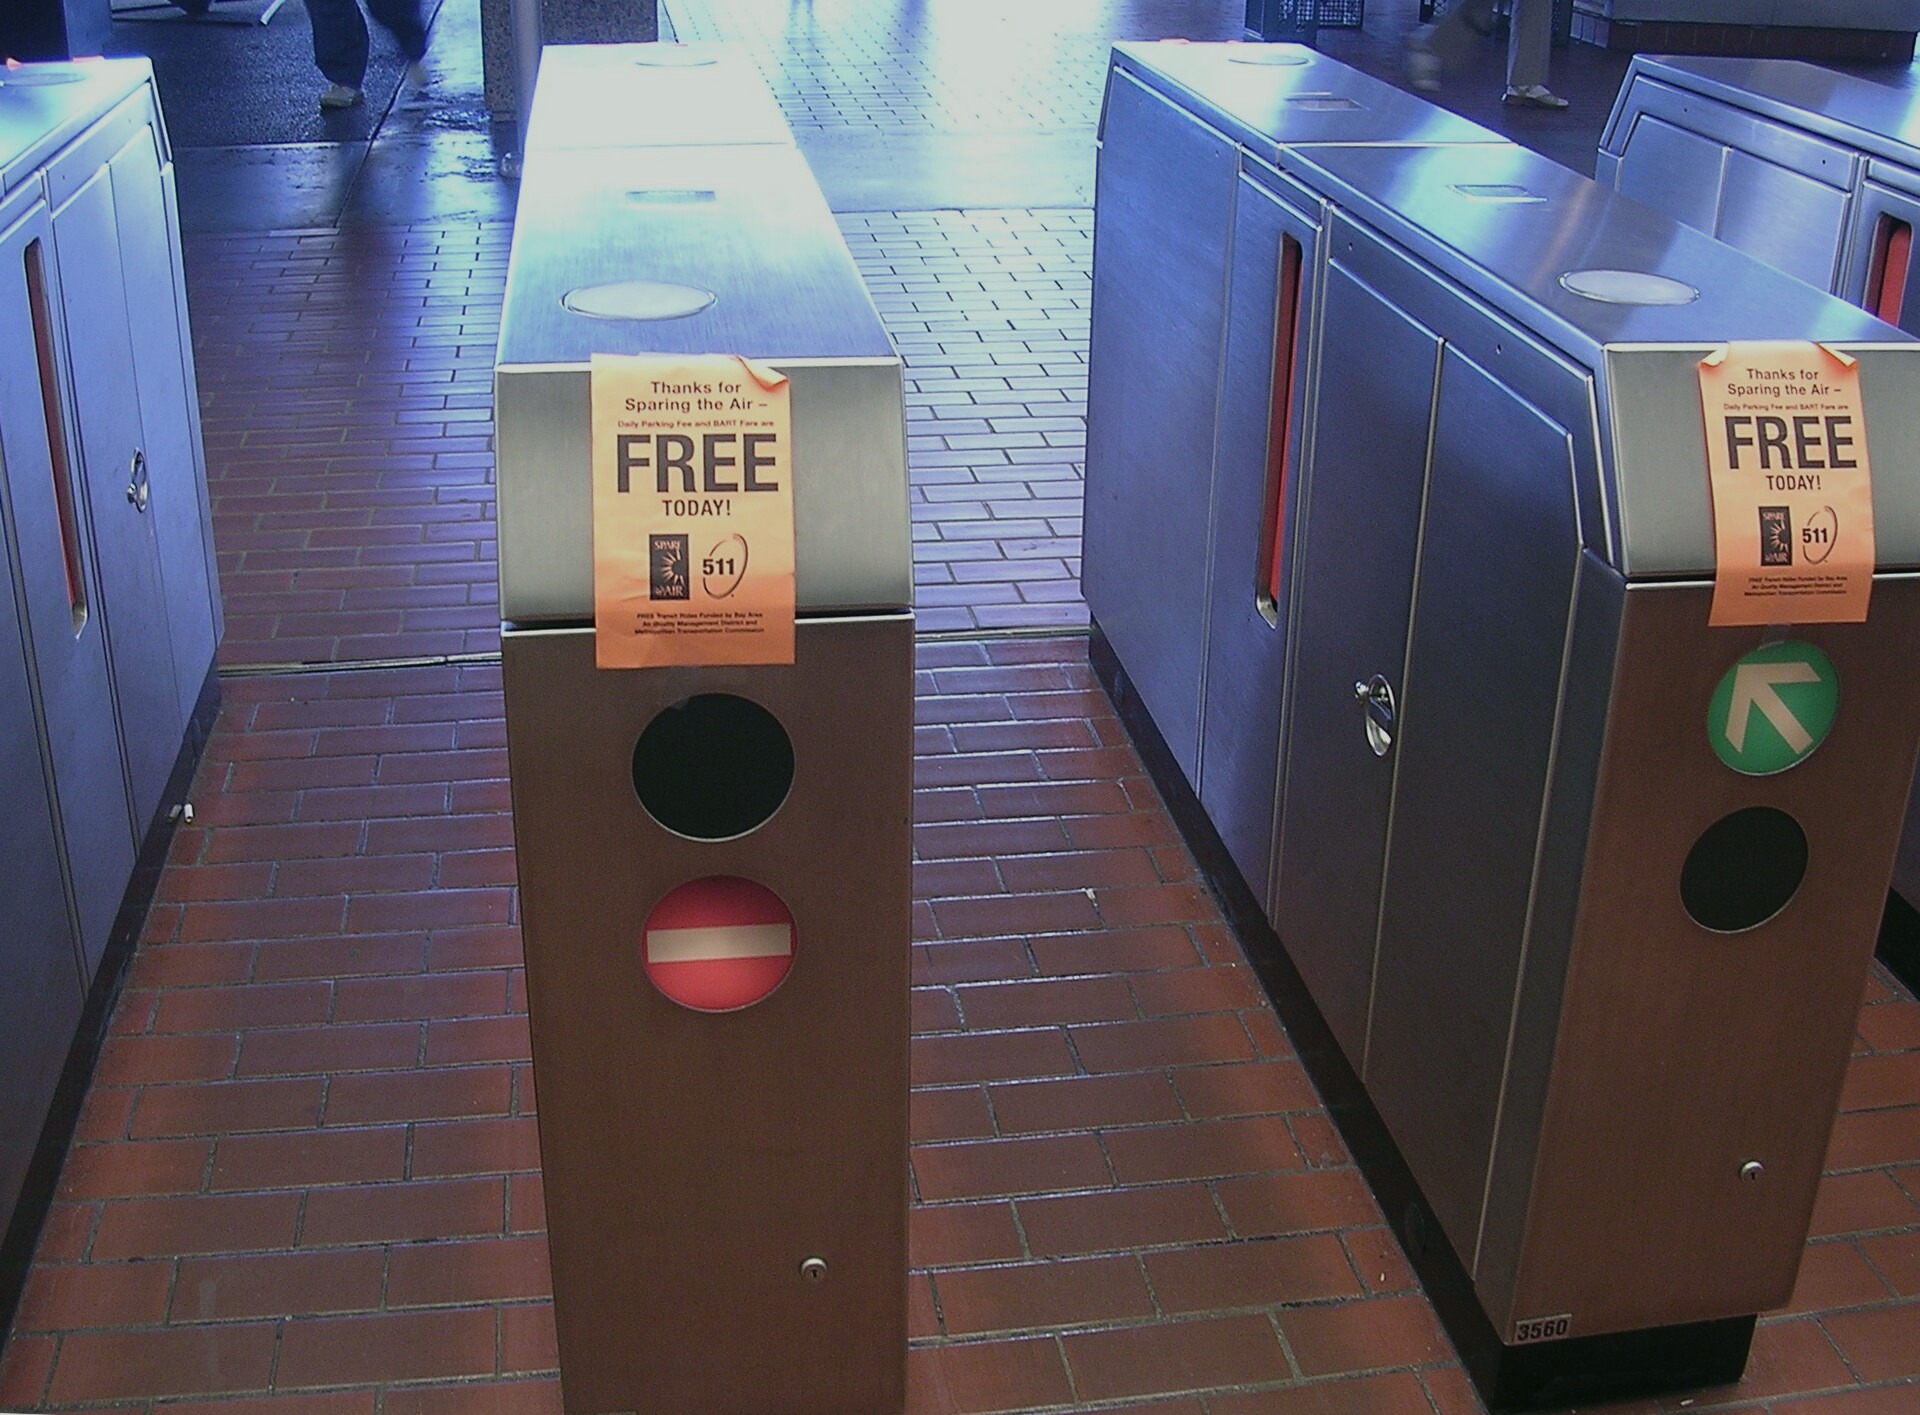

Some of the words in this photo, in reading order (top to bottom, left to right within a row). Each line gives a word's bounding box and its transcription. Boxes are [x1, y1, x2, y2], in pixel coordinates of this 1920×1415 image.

[1746, 368, 1796, 381] Thanks
[1800, 368, 1819, 380] for
[651, 381, 712, 394] Thanks
[719, 381, 741, 394] for
[1727, 383, 1781, 398] Sparing
[1785, 384, 1807, 395] the
[1811, 384, 1830, 395] Air
[625, 398, 691, 414] Sparing
[697, 398, 724, 411] the
[730, 397, 753, 410] Air
[1743, 403, 1769, 411] Parking
[617, 420, 639, 429] Daily
[641, 420, 674, 429] Parking
[676, 420, 692, 428] Fee
[695, 419, 711, 428] and
[713, 419, 737, 428] BART
[740, 419, 758, 428] Fare
[1724, 415, 1858, 470] FREE
[616, 432, 779, 494] FREE
[1765, 474, 1821, 491] TODAY!
[662, 499, 731, 517] TODAY!
[1802, 527, 1828, 543] 511
[702, 558, 735, 575] 511
[1517, 1319, 1569, 1341] 3560
